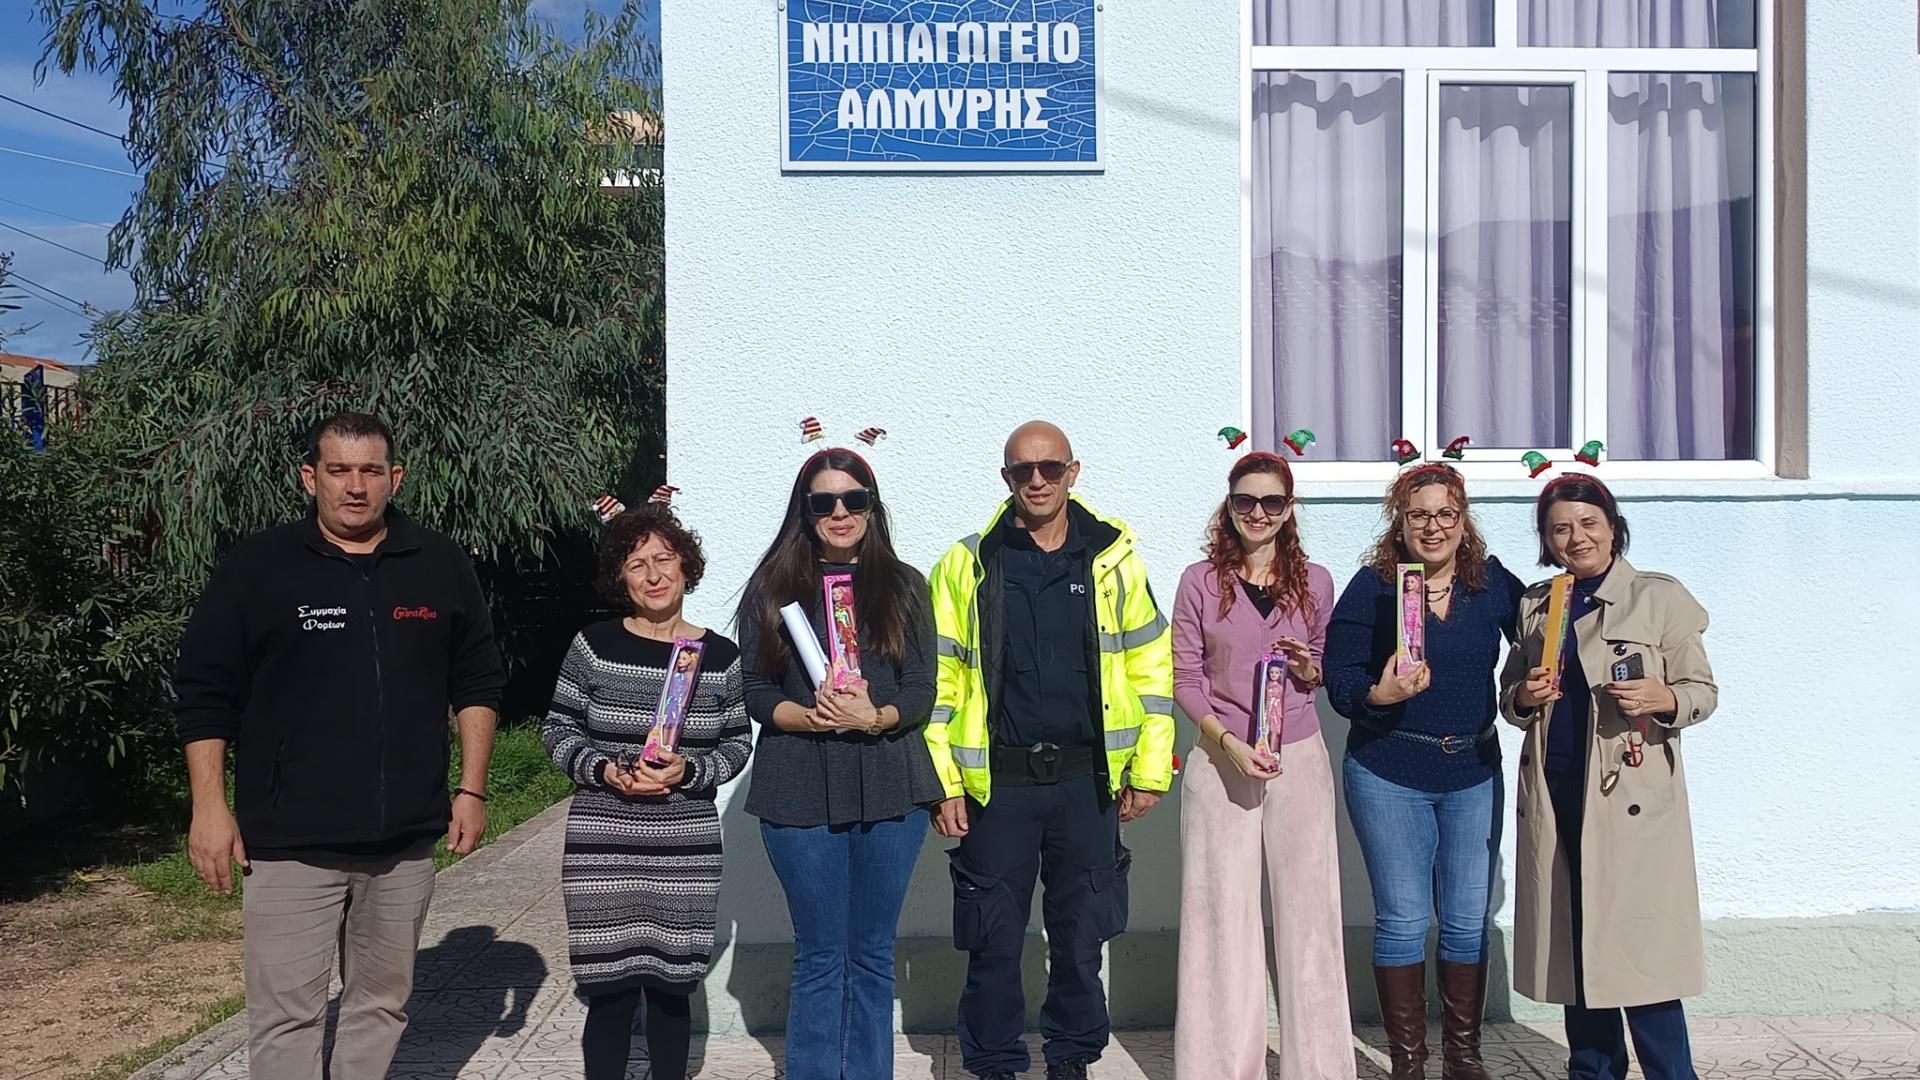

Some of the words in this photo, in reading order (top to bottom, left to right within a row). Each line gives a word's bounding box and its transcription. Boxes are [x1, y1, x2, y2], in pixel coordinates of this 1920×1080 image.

[802, 22, 1080, 64] ΝΗΠΙΑΓΩΓΕΙΟ
[837, 88, 1049, 129] ΑΛΜΥΡΗΣ
[297, 605, 347, 618] Συμμαχία
[302, 619, 346, 631] Φορέων
